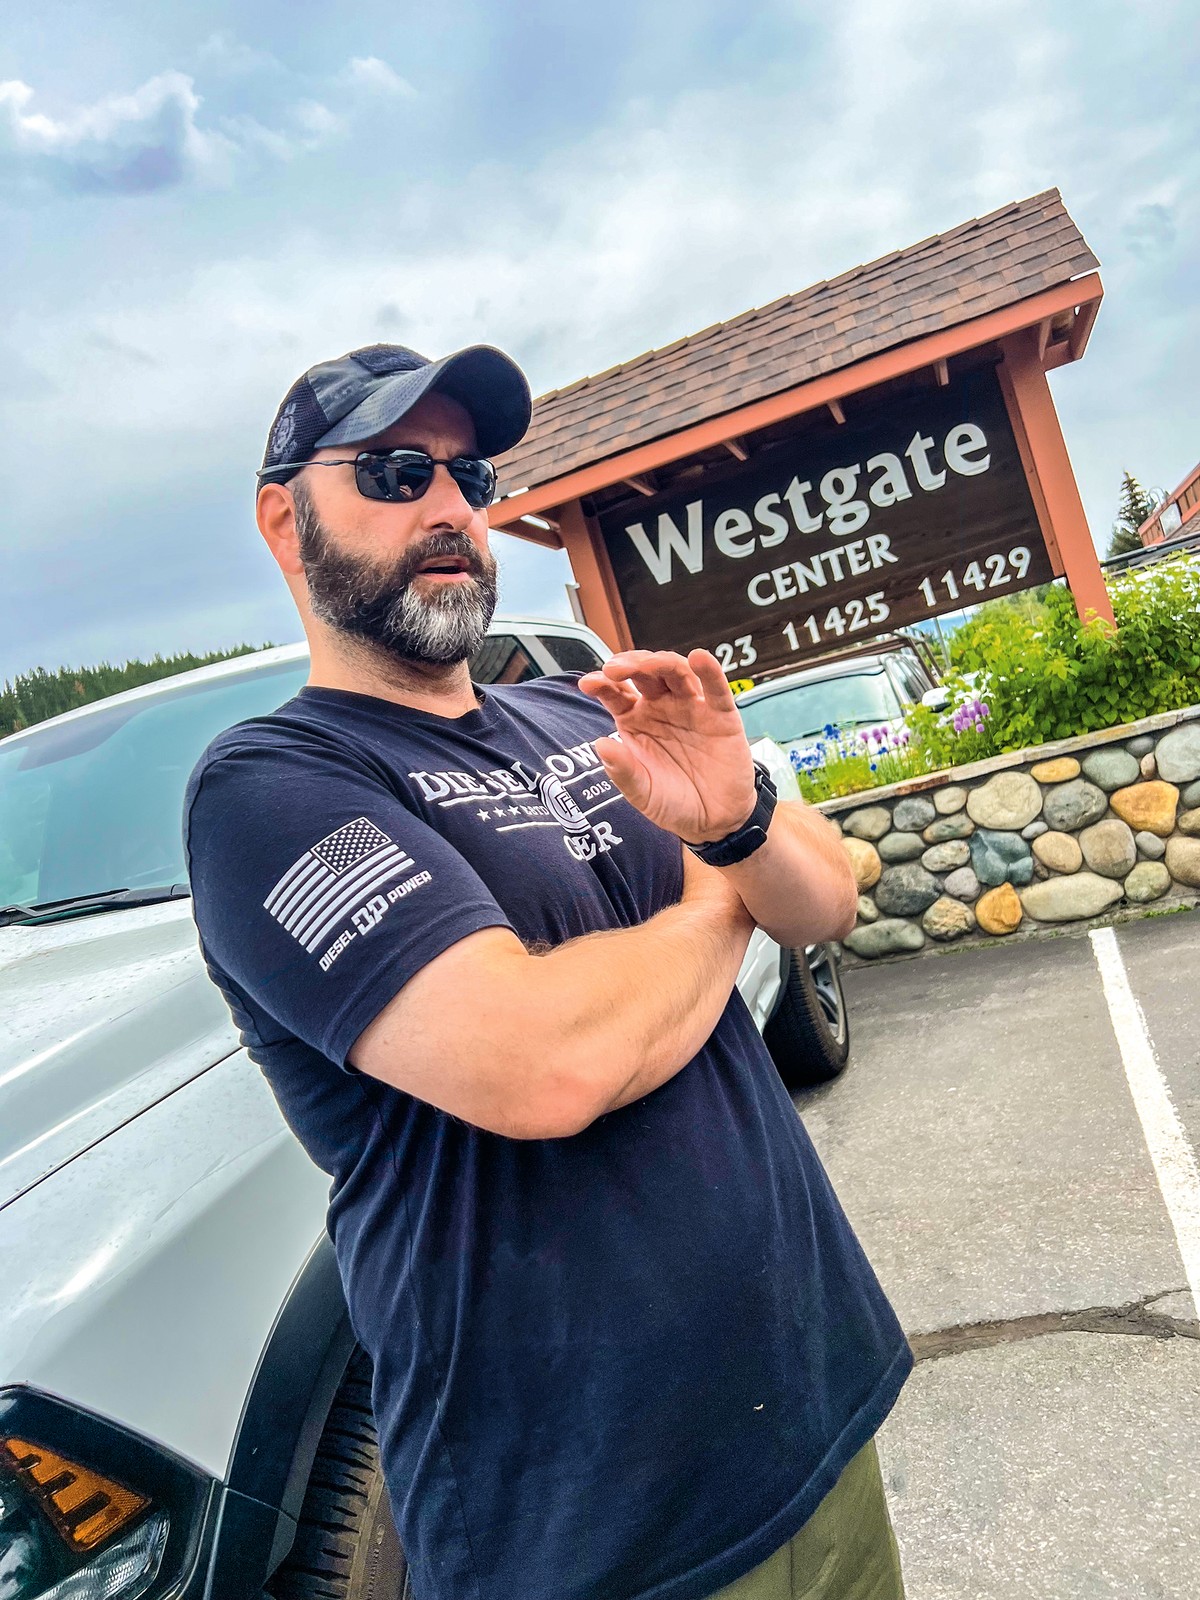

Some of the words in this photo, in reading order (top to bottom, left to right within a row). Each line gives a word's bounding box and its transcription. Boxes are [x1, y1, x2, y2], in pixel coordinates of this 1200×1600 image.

[625, 422, 991, 586] Westgate
[715, 634, 757, 673] 23
[782, 591, 891, 651] 11425
[918, 546, 1032, 607] 11429
[746, 533, 899, 607] CENTER
[319, 929, 357, 972] DIESEL
[387, 870, 432, 903] POWER
